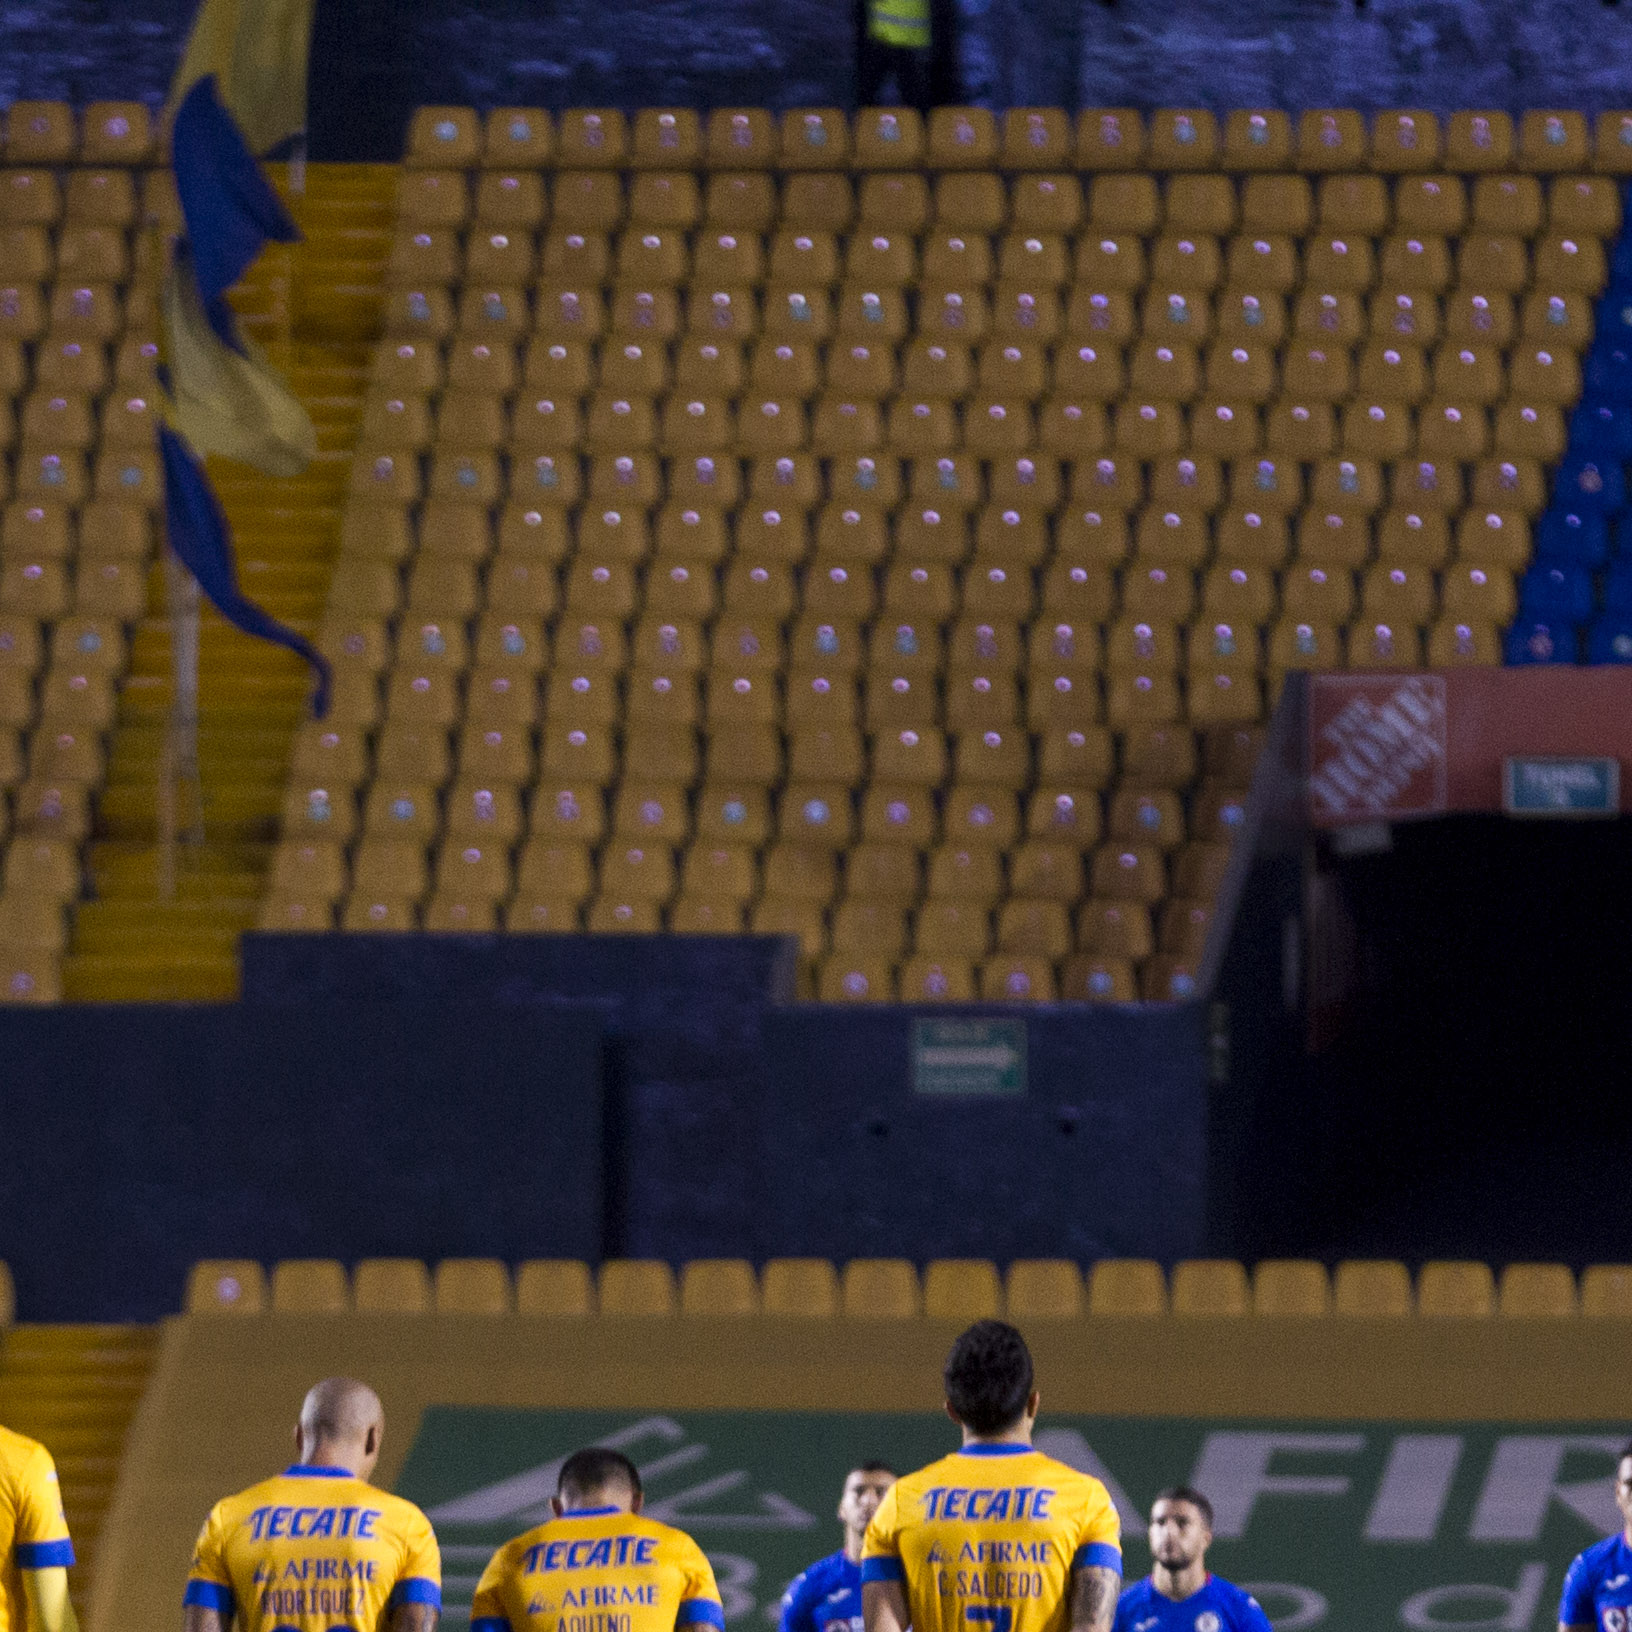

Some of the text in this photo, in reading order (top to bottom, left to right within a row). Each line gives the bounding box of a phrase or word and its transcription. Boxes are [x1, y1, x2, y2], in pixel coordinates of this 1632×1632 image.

[922, 1487, 1058, 1522] TECATE
[248, 1505, 382, 1544] TECATE
[523, 1536, 660, 1576] TECATE
[958, 1540, 1053, 1564] AFIRME
[283, 1559, 378, 1582] AFIRME
[561, 1584, 659, 1609] AFIRME
